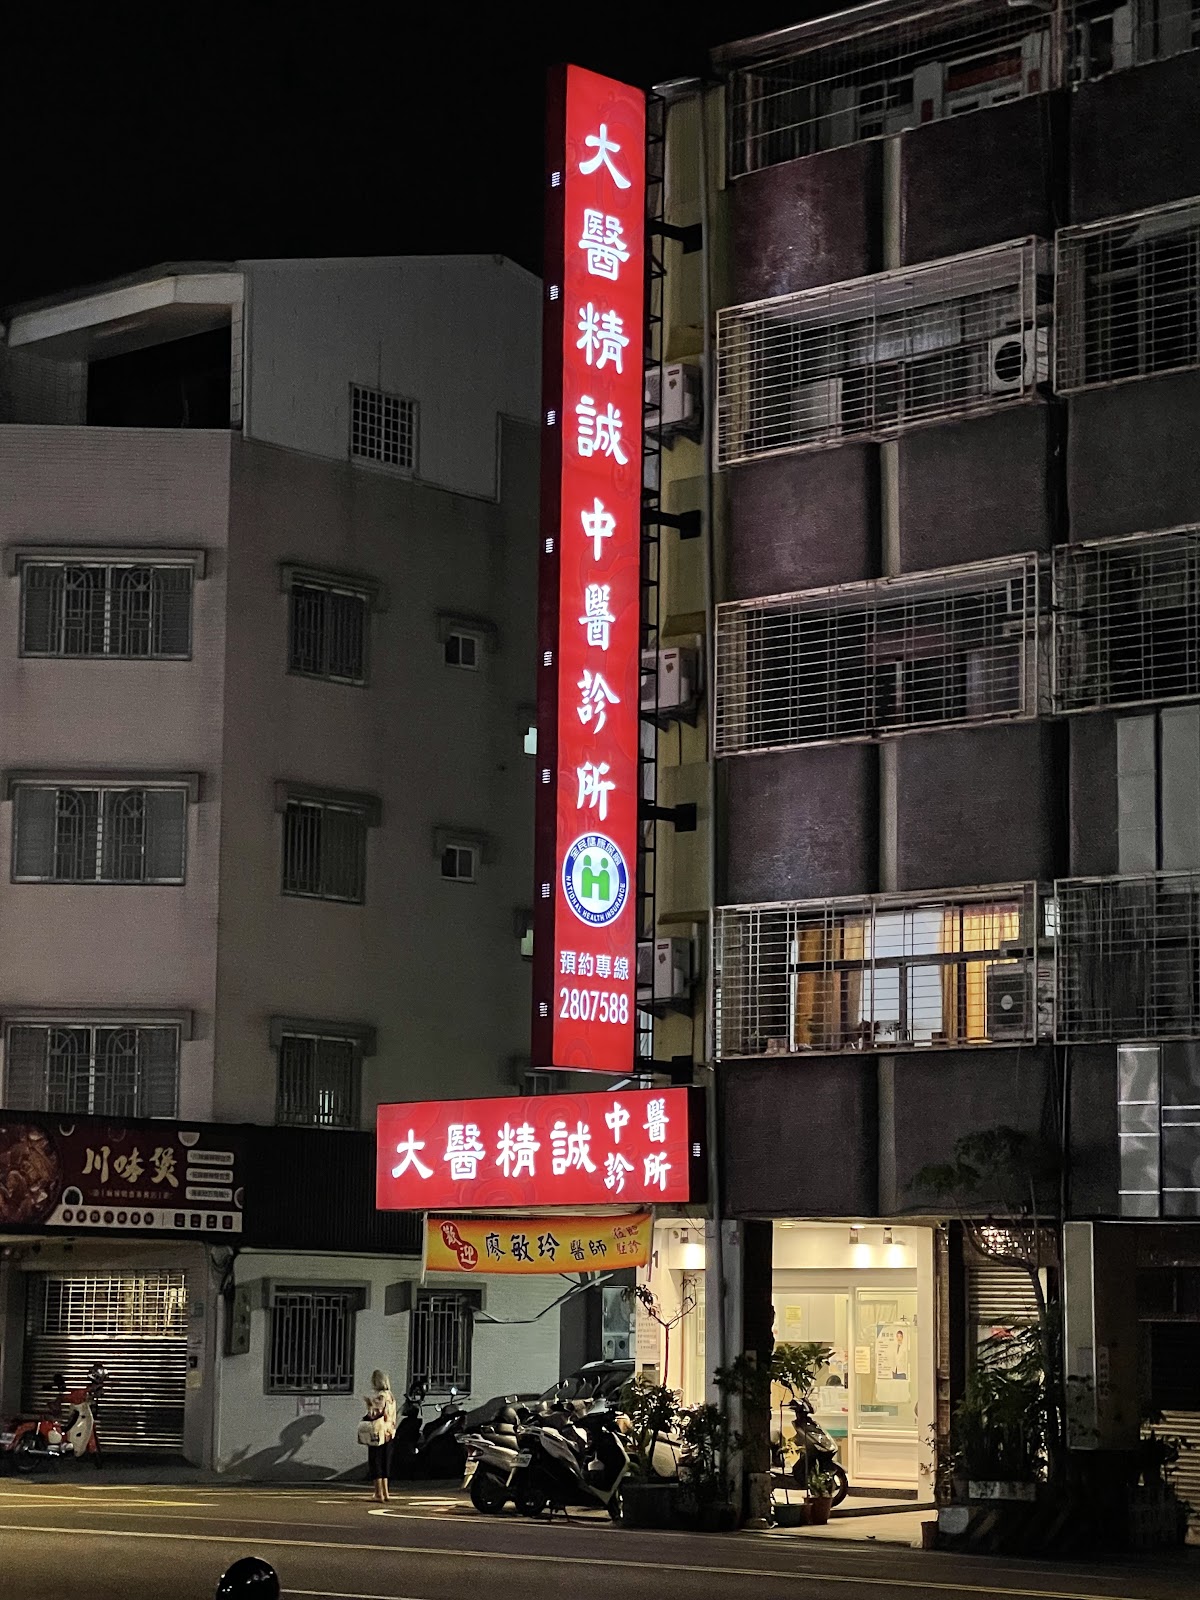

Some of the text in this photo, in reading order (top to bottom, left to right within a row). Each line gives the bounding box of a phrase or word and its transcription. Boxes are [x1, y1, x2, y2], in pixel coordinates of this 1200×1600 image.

[576, 122, 632, 822] 大醫精誠中醫診所
[565, 875, 626, 923] NATIONAL HEALTH INSURANCE
[559, 950, 630, 981] 預約專線
[559, 987, 629, 1026] 2807588
[82, 1145, 180, 1188] 川味煲
[391, 1119, 597, 1182] 大醫精誠
[485, 1232, 608, 1263] 廖敏玲 醫師
